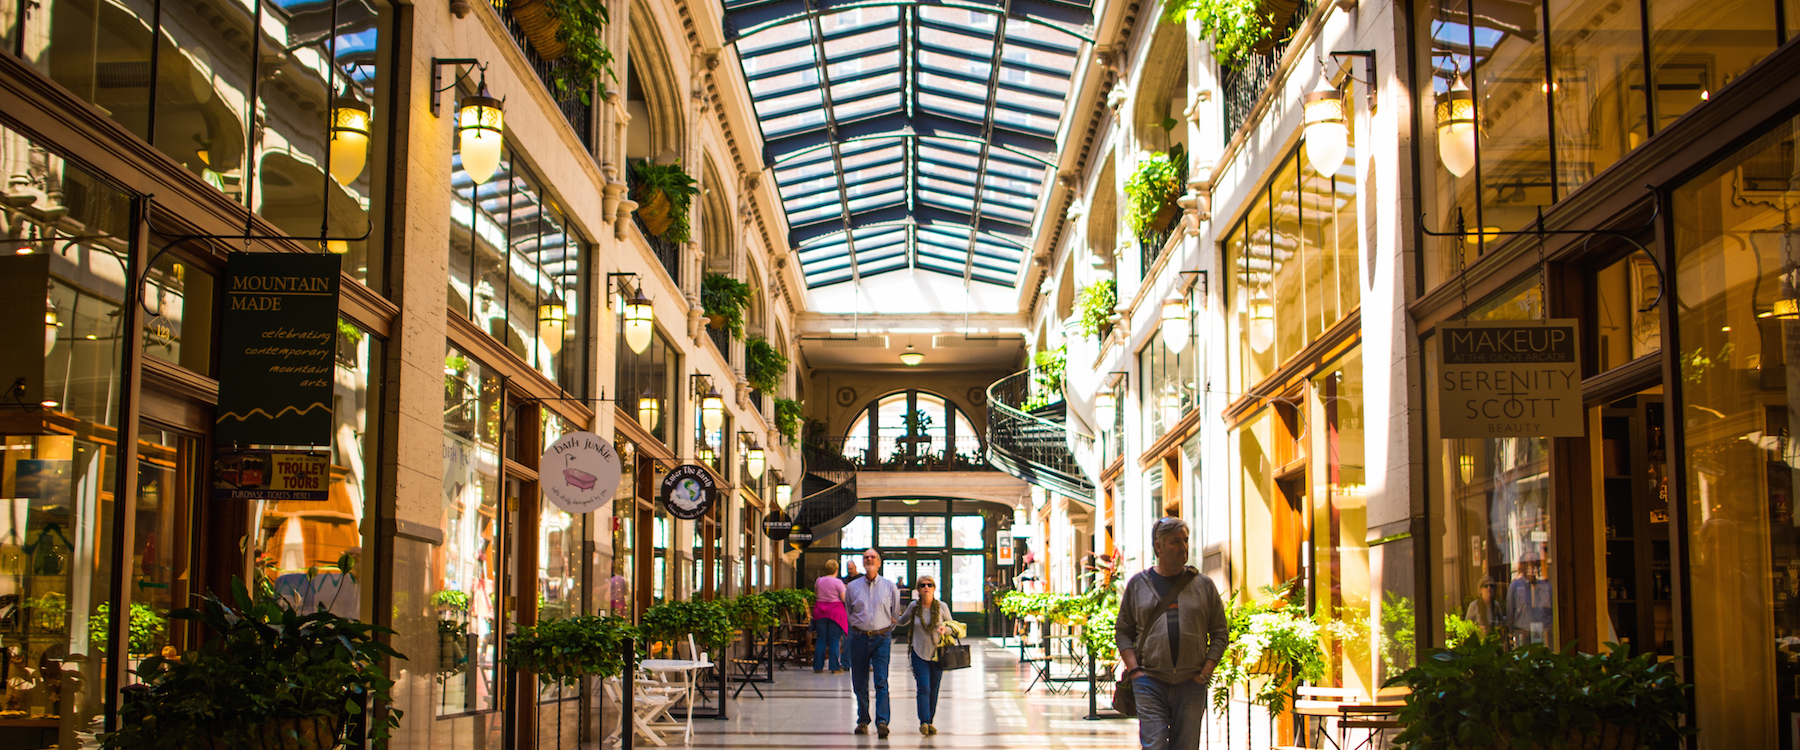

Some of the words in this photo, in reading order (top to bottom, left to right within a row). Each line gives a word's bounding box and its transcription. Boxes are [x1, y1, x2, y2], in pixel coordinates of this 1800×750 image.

[232, 275, 330, 291] MOUNTAIN
[231, 296, 282, 311] MADE
[156, 324, 170, 340] 123
[261, 326, 331, 346] celebrating
[1451, 329, 1566, 353] MAKEUP
[245, 346, 330, 360] contemporary
[1453, 354, 1466, 363] AT
[1467, 354, 1487, 362] THE
[1489, 353, 1523, 362] GROVE
[1525, 352, 1567, 361] ARCADE
[268, 364, 329, 374] mountain
[299, 378, 328, 388] arts
[1443, 369, 1576, 392] SERENITY
[1466, 398, 1561, 419] SCOTT
[1488, 423, 1541, 433] BEAUTY
[277, 461, 326, 475] TROLLEY
[283, 476, 319, 489] TOURS
[664, 469, 682, 486] Enter
[682, 465, 696, 475] The
[695, 468, 713, 488] Earth
[231, 490, 264, 499] PURCHASE
[267, 490, 291, 500] TICKETS
[292, 491, 311, 500] HERE!
